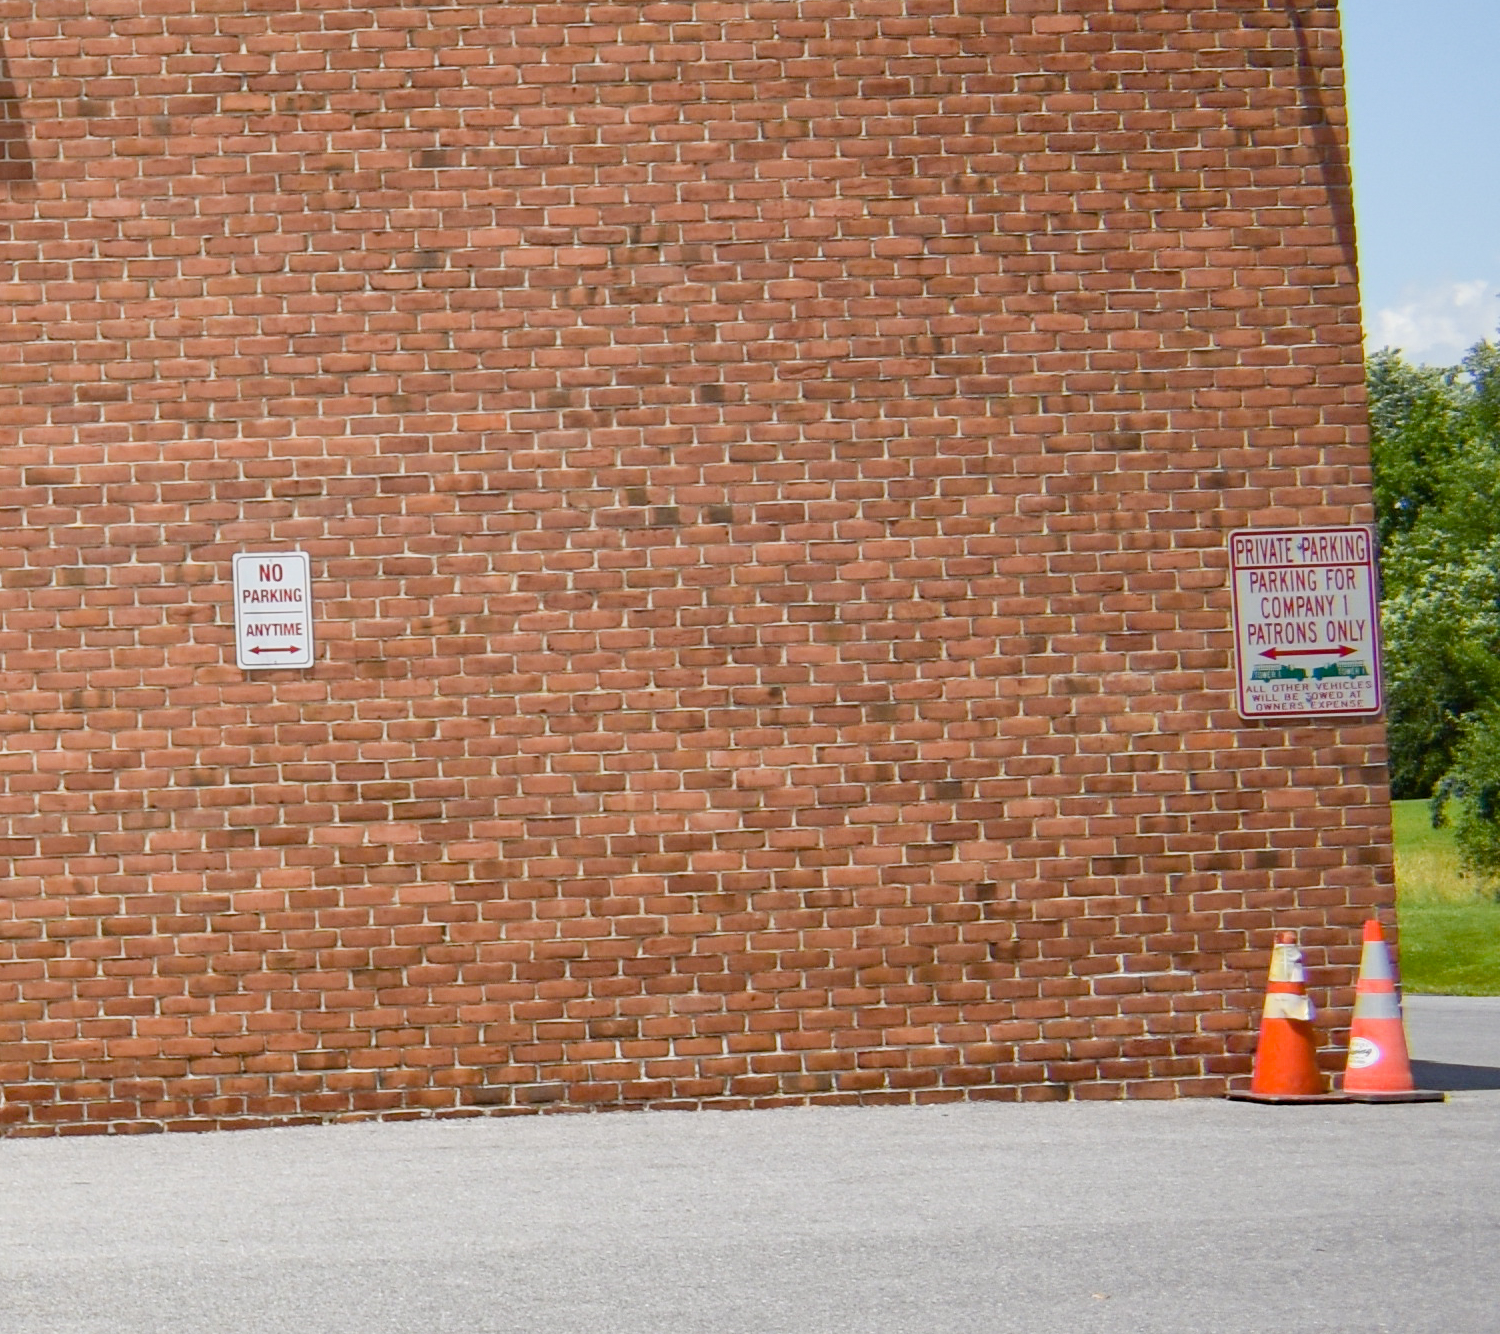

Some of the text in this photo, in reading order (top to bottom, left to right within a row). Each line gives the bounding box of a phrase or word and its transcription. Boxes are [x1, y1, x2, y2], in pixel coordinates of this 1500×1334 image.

[1236, 534, 1365, 565] PRIVATE PARKING
[259, 563, 283, 582] NO
[1249, 568, 1356, 594] PARKING FOR
[242, 588, 303, 604] PARKING
[1261, 594, 1349, 619] COMPANY 1
[246, 623, 303, 637] ANYTIME
[1247, 619, 1365, 646] PATRONS ONLY
[1246, 680, 1372, 693] ALL OTHER VEHICLES
[1252, 693, 1278, 702] WILL
[1285, 692, 1299, 701] BE
[1350, 690, 1361, 698] AT
[1256, 700, 1364, 711] OWNERS EXPENSE
